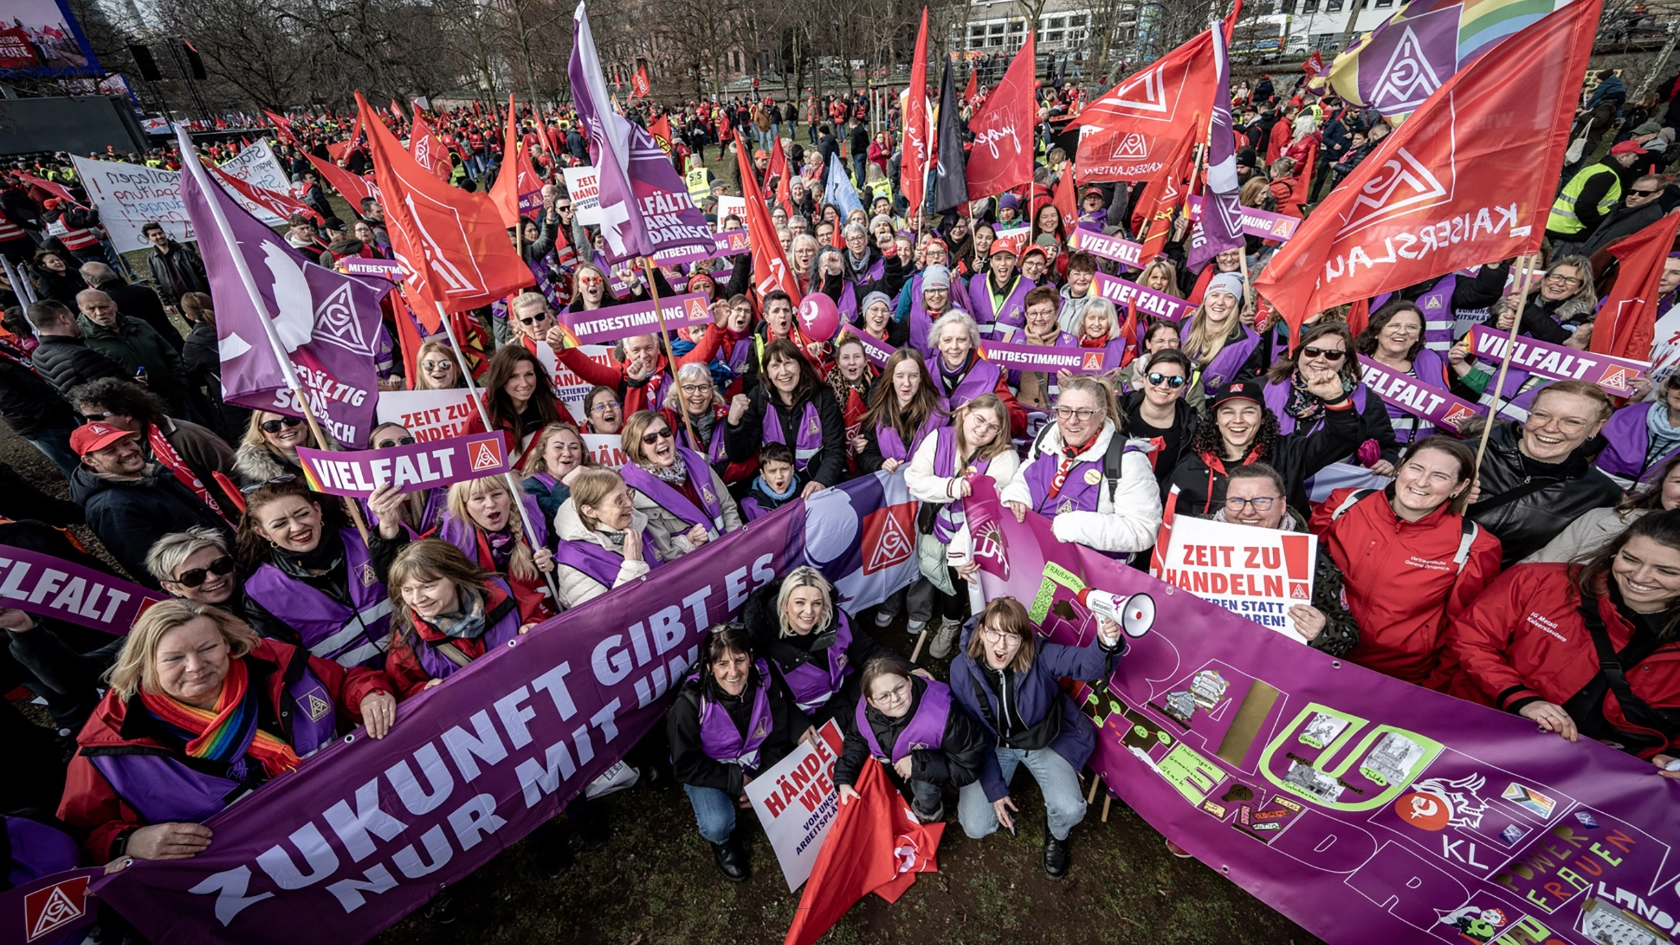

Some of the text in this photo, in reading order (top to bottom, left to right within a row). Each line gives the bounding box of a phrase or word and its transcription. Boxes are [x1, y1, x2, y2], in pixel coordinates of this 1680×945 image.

[576, 175, 597, 188] ZEIT
[1080, 233, 1142, 264] VIELFALT
[1102, 280, 1180, 318] VIELFALT
[574, 304, 684, 338] MITBESTIMMUNG
[987, 348, 1081, 368] MITBESTIMMUNG
[1476, 332, 1598, 380] VIELFALT
[400, 402, 469, 429] ZEIT ZU
[310, 447, 455, 492] VIELFALT
[1183, 544, 1281, 570] ZEIT ZU
[1166, 568, 1284, 598] HANDELN
[1241, 600, 1284, 614] STATT
[1539, 613, 1558, 629] Metall
[1526, 616, 1567, 642] Kaiserslautern
[188, 552, 776, 927] ZUKUNFT GIBT ES
[1179, 745, 1213, 771] Thüringen
[763, 740, 832, 819] HÄNDE
[1161, 766, 1185, 787] Stark
[1364, 768, 1384, 784] Fulda
[325, 792, 508, 914] NUR
[515, 696, 621, 809] MIT
[803, 811, 820, 831] VON
[1442, 834, 1489, 871] KL
[1494, 825, 1589, 892] POWER
[1526, 829, 1637, 914] FRAUEN
